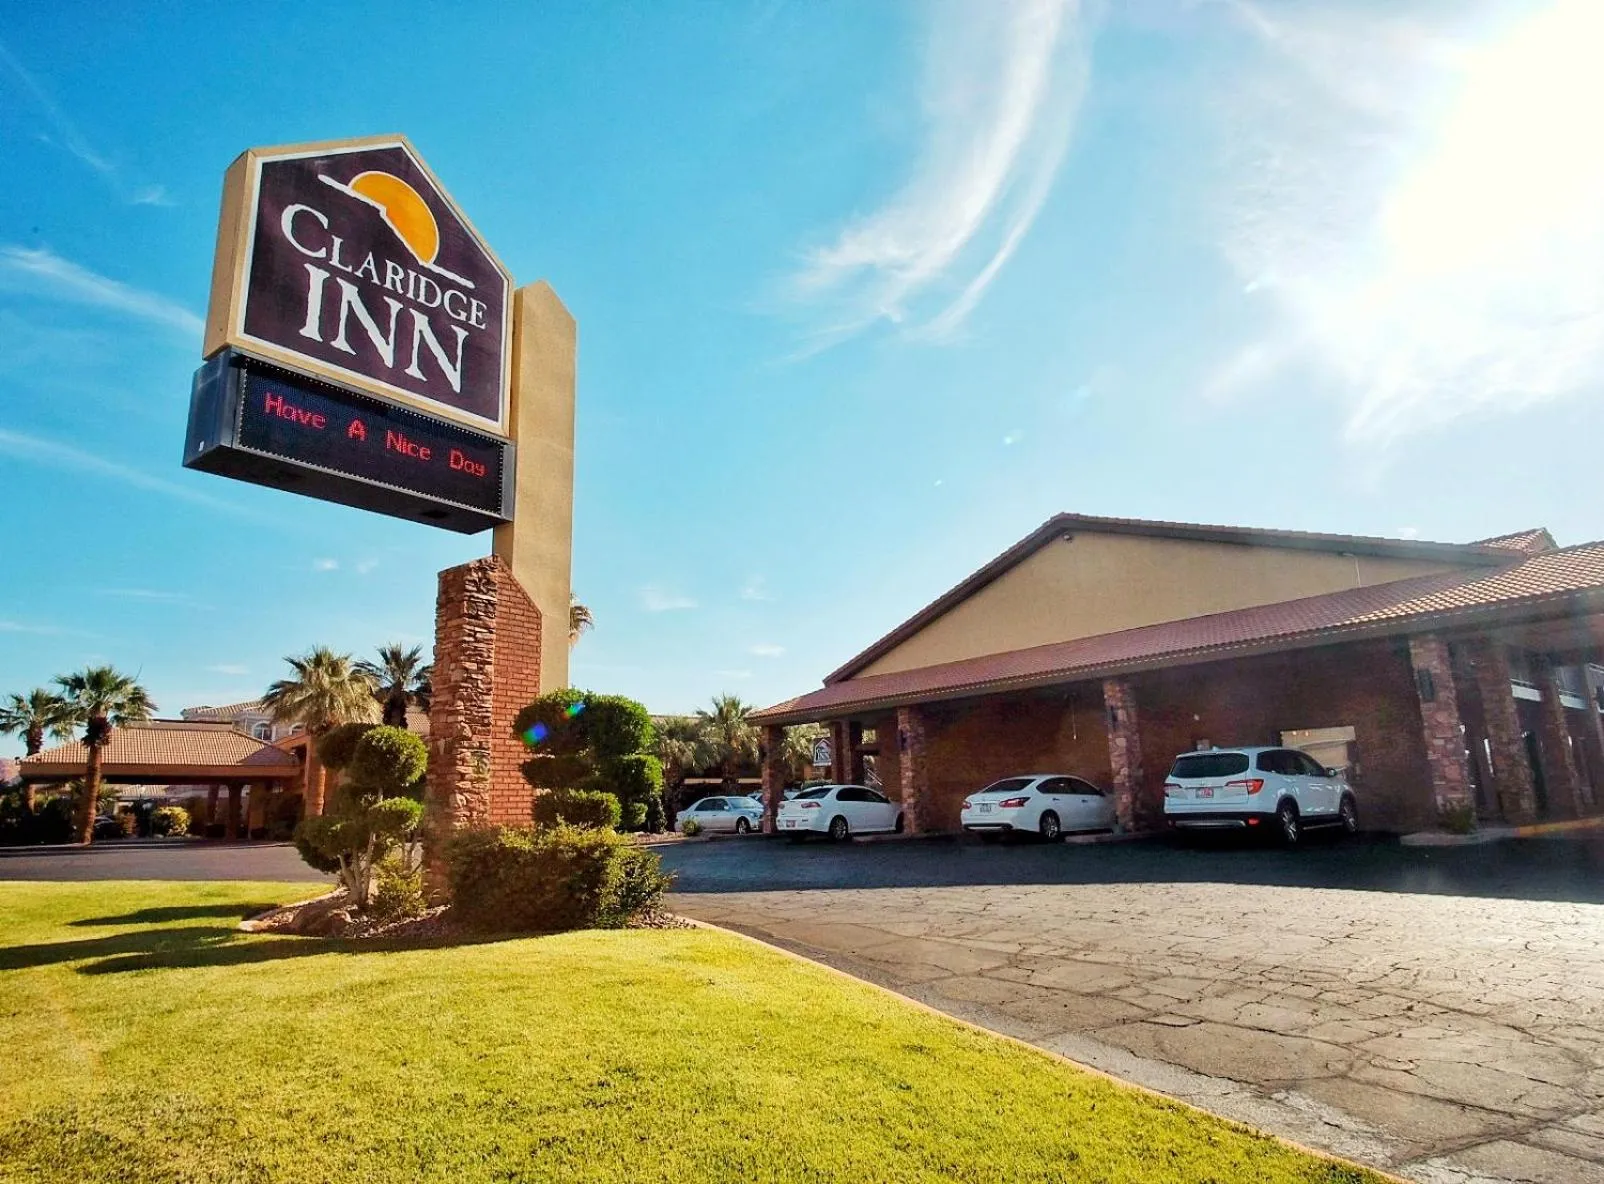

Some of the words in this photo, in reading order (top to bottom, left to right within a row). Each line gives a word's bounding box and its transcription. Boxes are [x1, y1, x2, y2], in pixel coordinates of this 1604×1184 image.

[281, 204, 487, 329] CLARIDGE
[299, 264, 469, 393] INN
[264, 393, 326, 429] Have
[348, 419, 366, 441] A
[386, 430, 431, 461] Nice
[450, 450, 487, 478] Day
